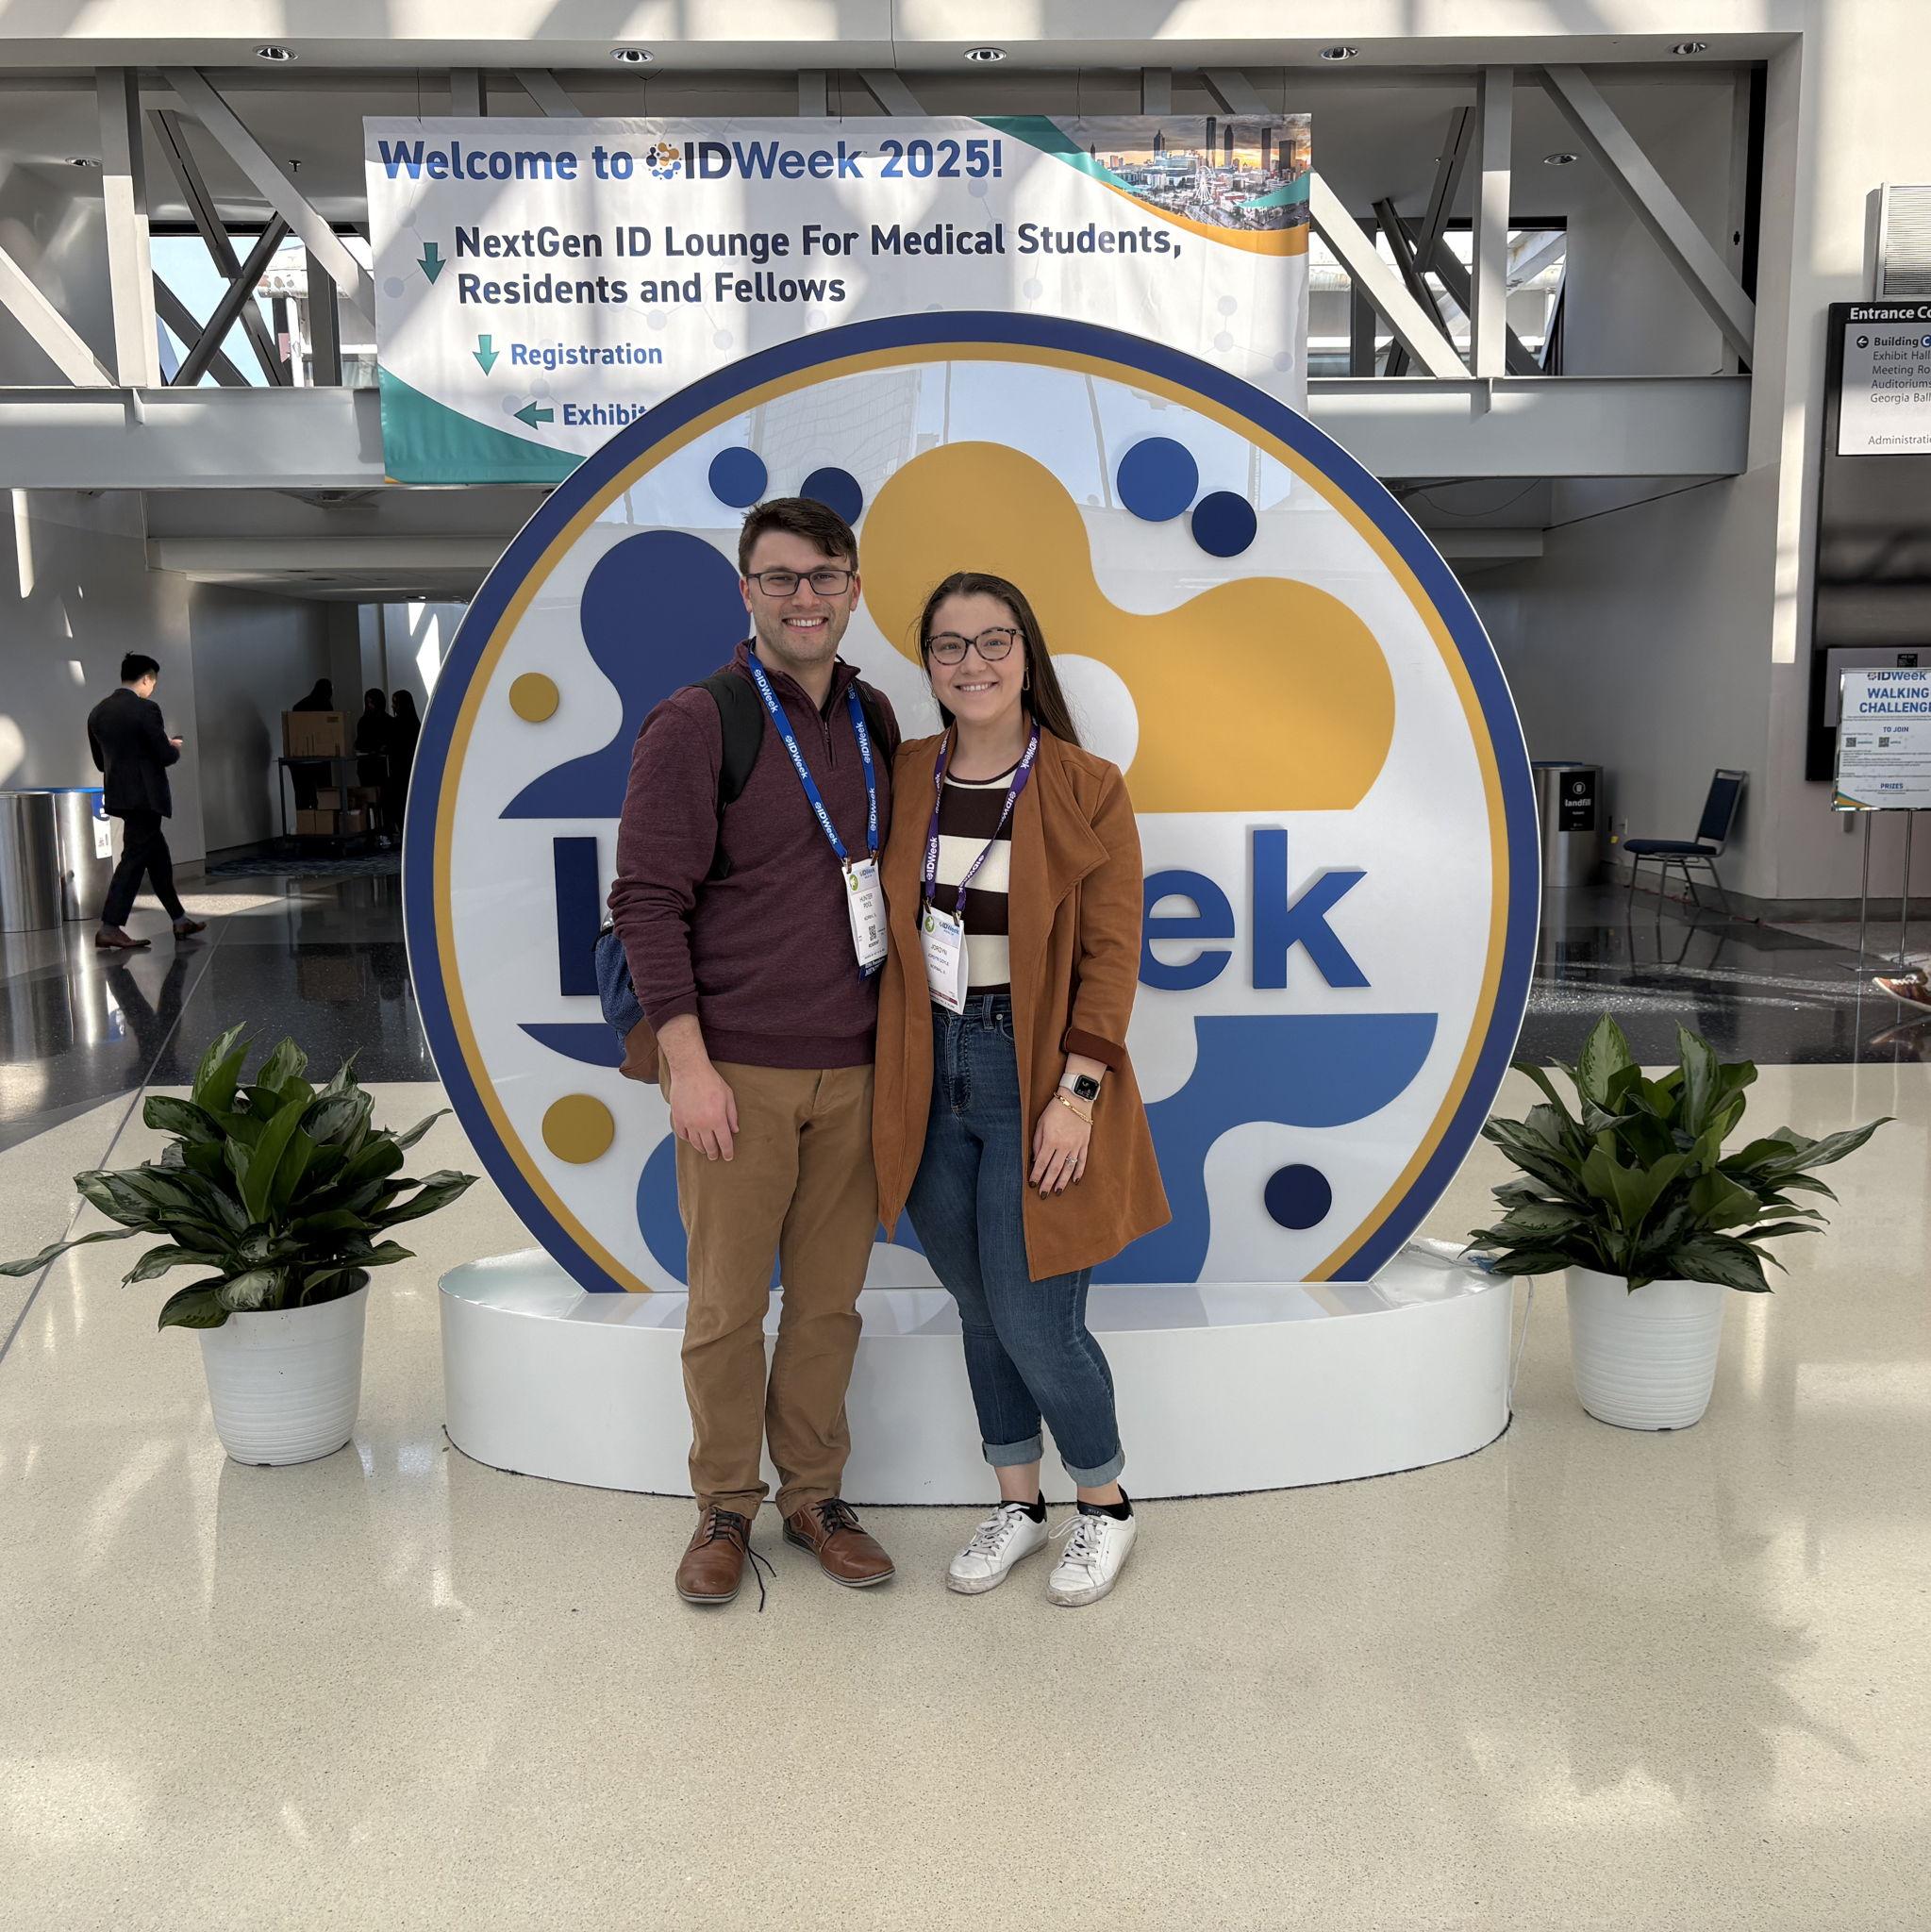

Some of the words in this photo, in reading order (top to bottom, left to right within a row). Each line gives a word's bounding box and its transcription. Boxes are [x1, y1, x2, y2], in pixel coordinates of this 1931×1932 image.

[378, 141, 577, 180] Welcome
[591, 145, 634, 180] to
[684, 141, 865, 179] IDWeek
[879, 139, 1003, 178] 2025!
[455, 225, 603, 258] NextGen
[616, 225, 652, 258] ID
[665, 225, 789, 264] Lounge
[803, 224, 858, 257] For
[871, 224, 1006, 256] Medical
[1016, 223, 1182, 258] Students,
[458, 273, 628, 305] Residents
[641, 273, 702, 303] and
[715, 272, 846, 303] Fellows
[1850, 307, 1915, 320] Entrance
[1873, 337, 1919, 348] Building
[1873, 351, 1907, 360] Exhibit
[510, 343, 663, 371] Registration
[1872, 365, 1914, 376] Meeting
[1870, 392, 1910, 405] Georgia
[1868, 435, 1931, 445] Administrati
[1877, 671, 1926, 681] IDWeek
[756, 673, 779, 714] IDWeek
[1867, 688, 1929, 699] WALKING
[856, 721, 871, 757] IDWeek
[788, 741, 808, 779] IDWeek
[1020, 741, 1038, 770] IDWeek
[1564, 798, 1592, 807] landfill
[818, 807, 838, 845] IDWeek
[926, 837, 938, 874] IDWeek
